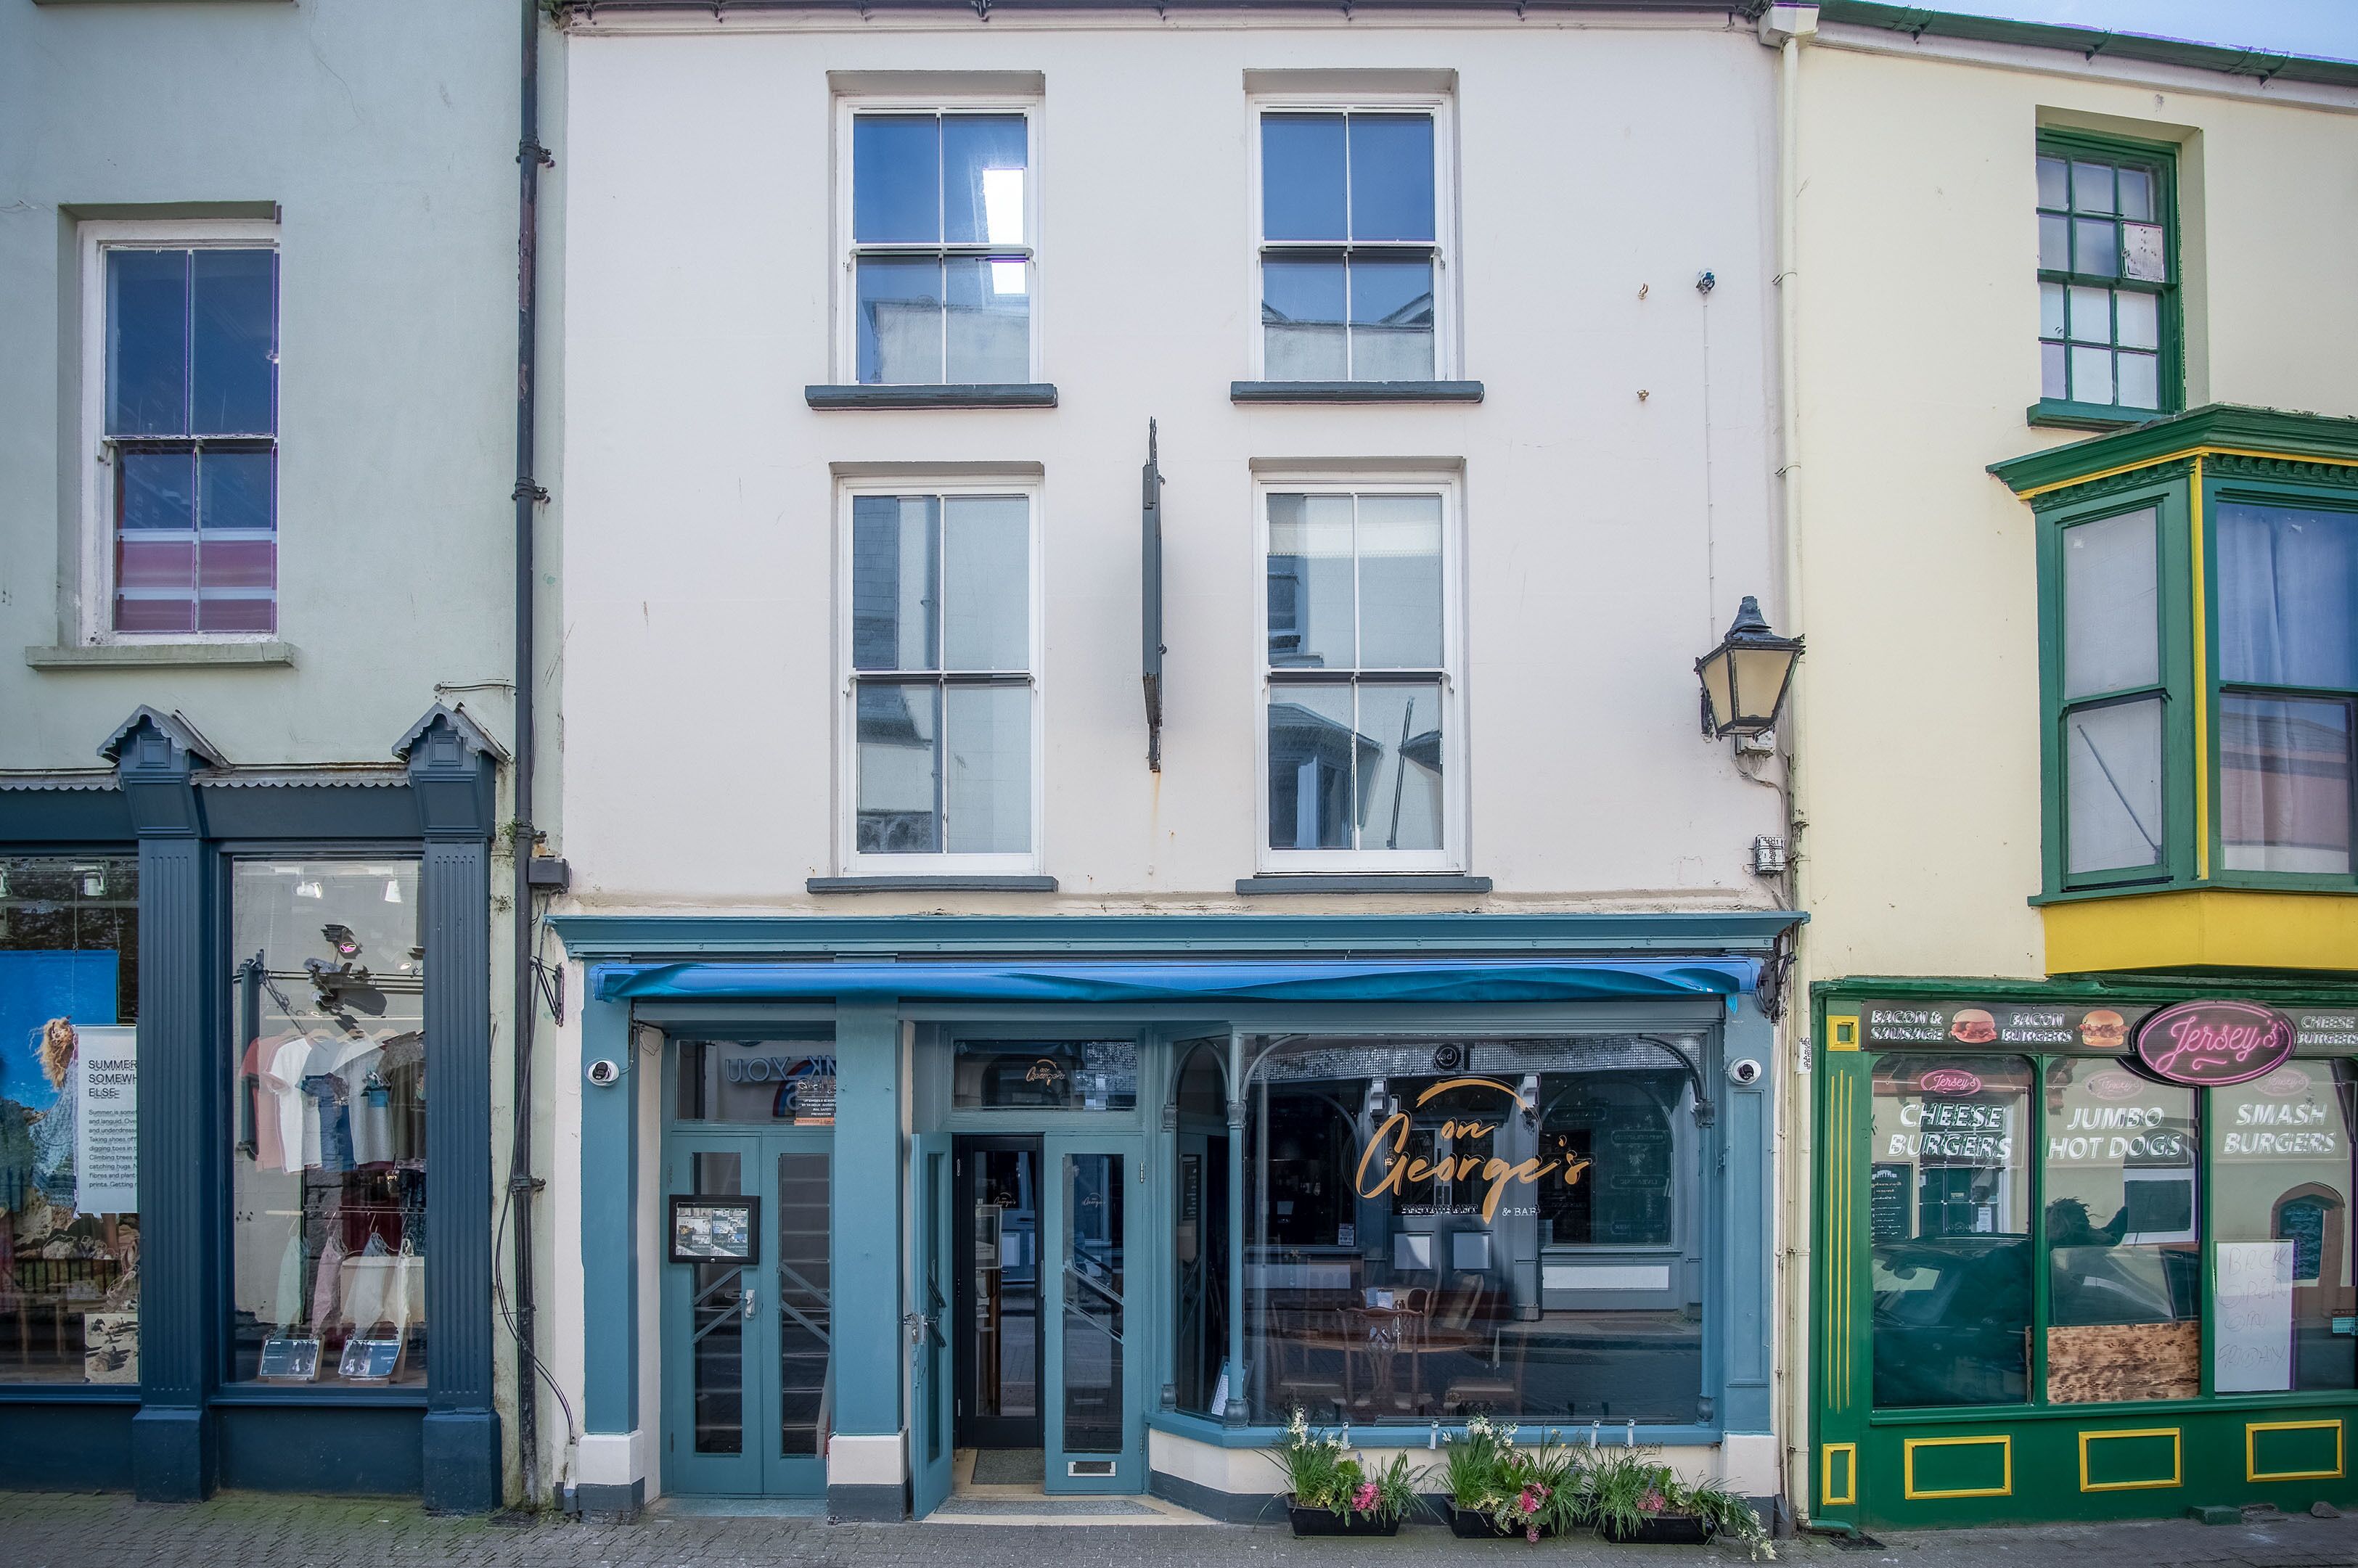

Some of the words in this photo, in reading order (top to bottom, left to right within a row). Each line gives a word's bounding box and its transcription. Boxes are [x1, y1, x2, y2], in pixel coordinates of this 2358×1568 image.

[1871, 1010, 1928, 1025] BACON
[1930, 1011, 1944, 1025] &
[2009, 1012, 2065, 1027] BACON
[2301, 1015, 2355, 1029] CHEESE
[1870, 1027, 1944, 1040] SAUSAGE
[2002, 1028, 2073, 1043] BURGERS
[2296, 1031, 2358, 1045] BURGERS
[2155, 1016, 2283, 1072] Jersey's
[89, 1060, 136, 1069] SUMMER
[1929, 1074, 1976, 1091] Jersey's
[89, 1088, 117, 1097] ELSE
[1900, 1103, 2004, 1128] CHEESE
[2067, 1107, 2164, 1130] JUMBO
[2236, 1103, 2327, 1125] SMASH
[1441, 1117, 1498, 1139] on
[1888, 1133, 2012, 1159] BURGERS
[2048, 1136, 2104, 1159] HOT
[2108, 1133, 2182, 1159] DOGS
[2224, 1133, 2336, 1154] BURGERS
[1356, 1110, 1592, 1224] George's
[1502, 1207, 1511, 1216] &
